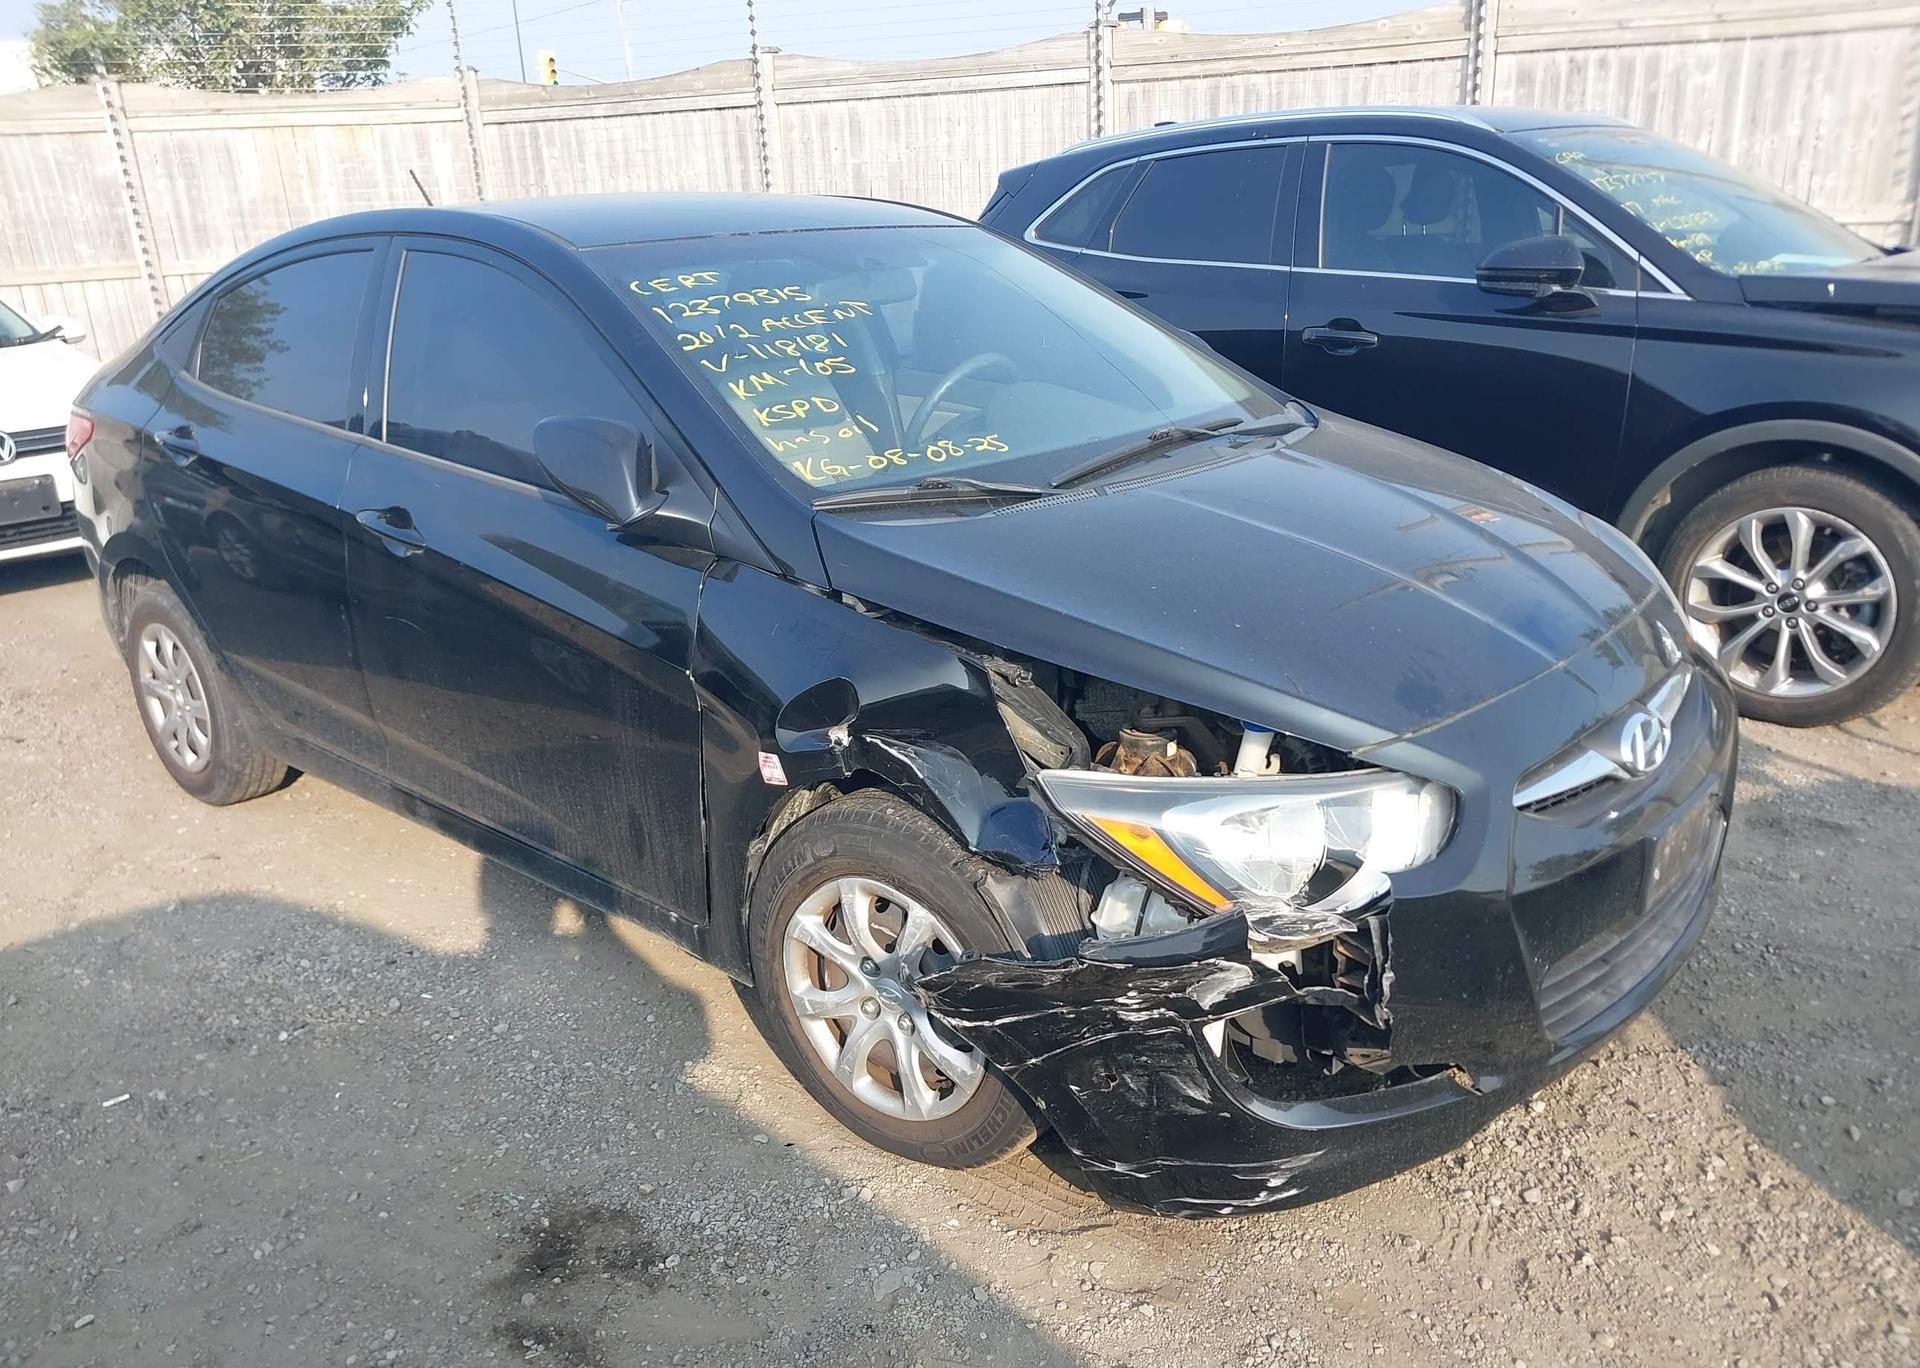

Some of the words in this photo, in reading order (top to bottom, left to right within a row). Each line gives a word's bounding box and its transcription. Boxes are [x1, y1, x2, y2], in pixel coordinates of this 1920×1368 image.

[629, 271, 720, 295] CERT
[652, 287, 812, 324] 12379315
[677, 323, 761, 351] 2012
[761, 301, 874, 332] ACCENT
[753, 396, 840, 427] KSPD
